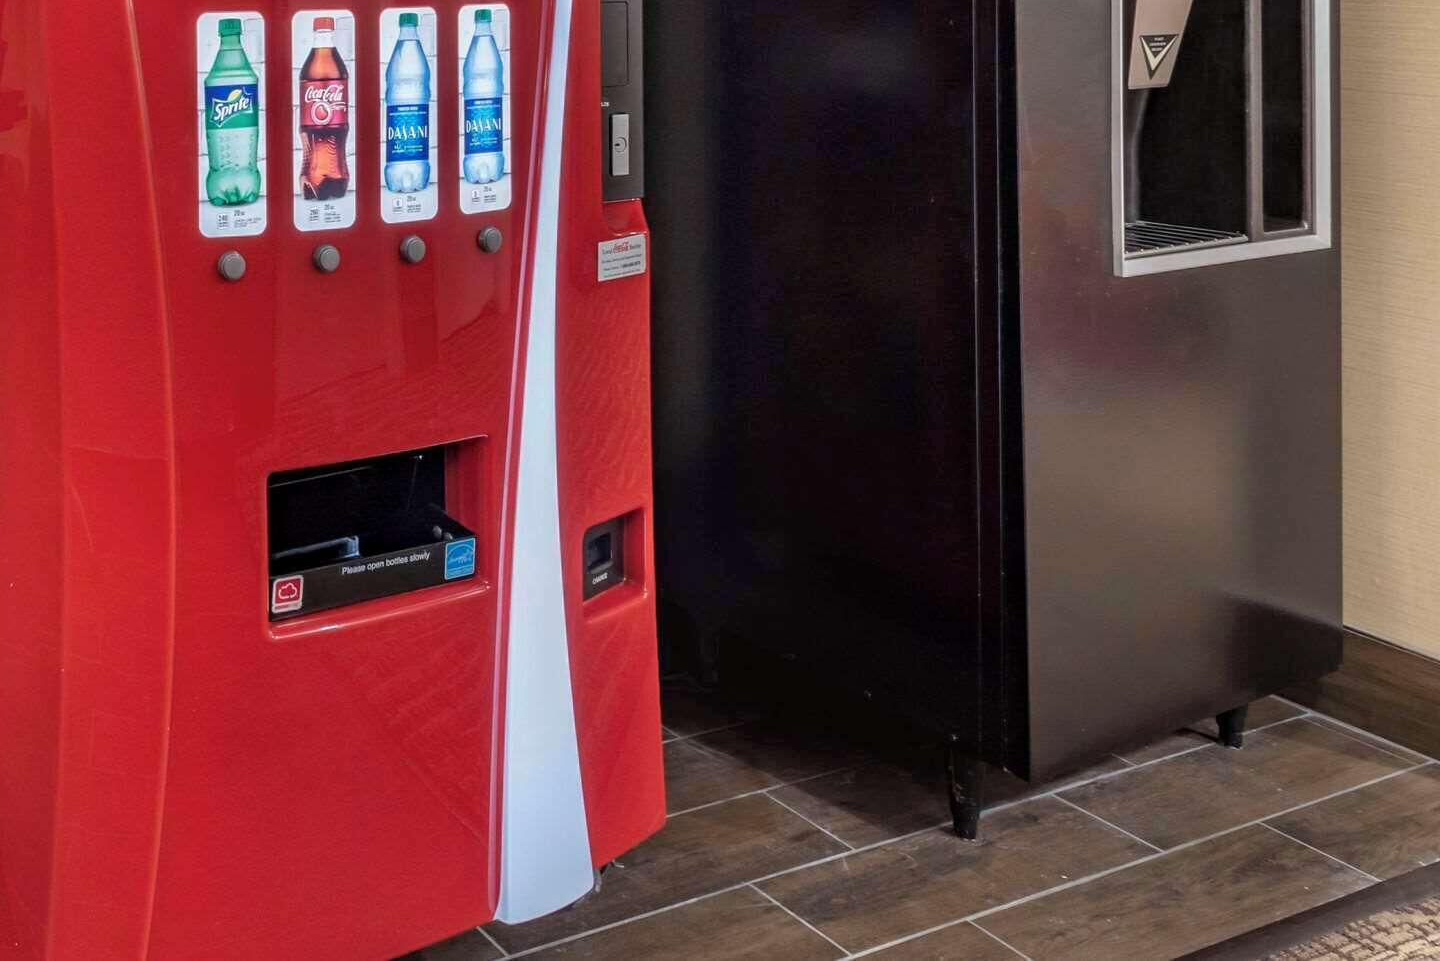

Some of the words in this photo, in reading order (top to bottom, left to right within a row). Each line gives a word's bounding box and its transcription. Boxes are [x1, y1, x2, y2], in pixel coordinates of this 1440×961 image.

[304, 84, 344, 104] Coca-Cola
[212, 96, 251, 121] Sprite
[387, 125, 429, 142] DASANI
[465, 116, 503, 134] DASANI
[341, 563, 366, 575] Please
[366, 560, 385, 572] open
[385, 555, 409, 567] bottles
[409, 550, 431, 563] slowly
